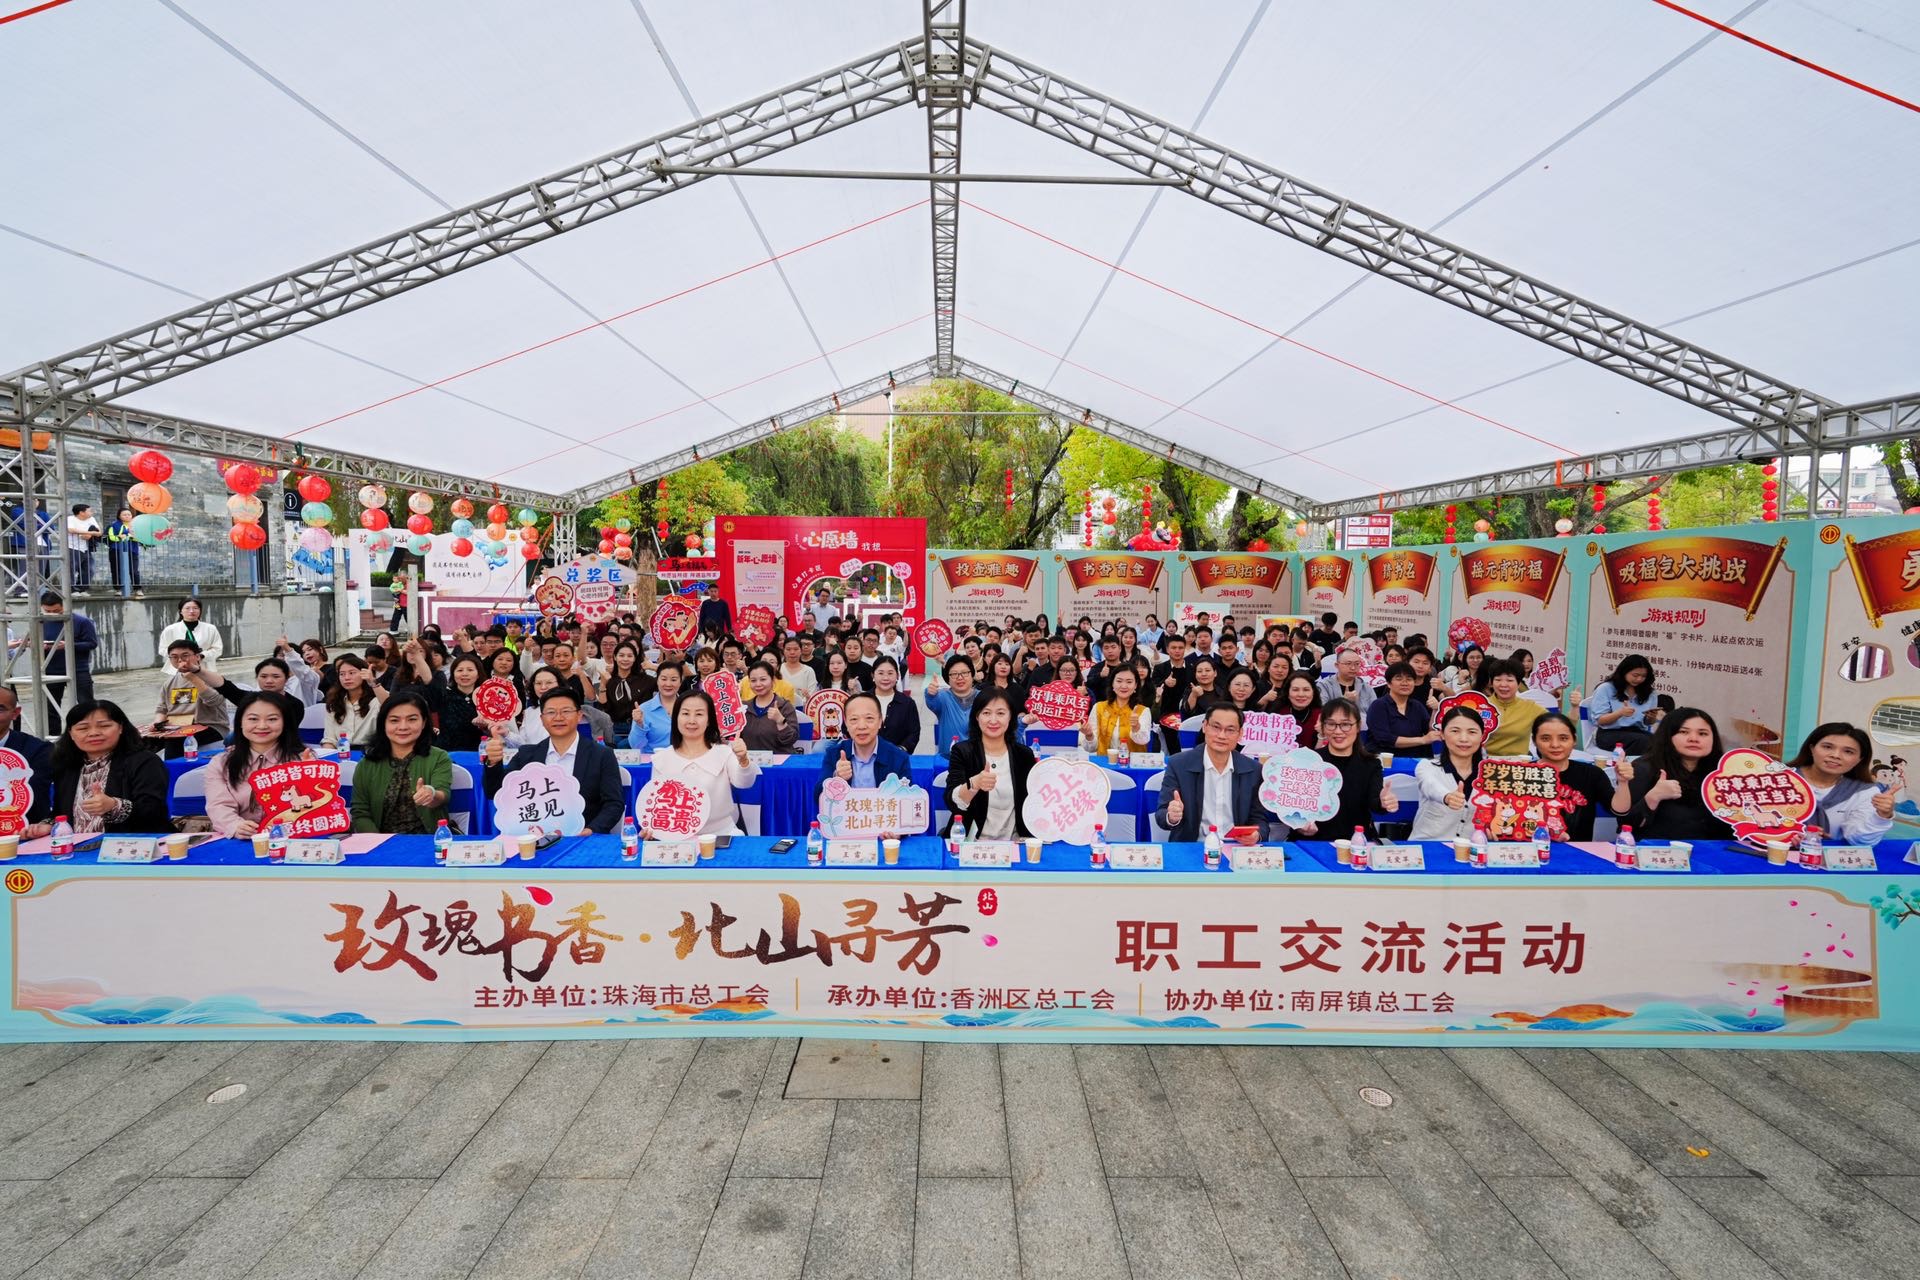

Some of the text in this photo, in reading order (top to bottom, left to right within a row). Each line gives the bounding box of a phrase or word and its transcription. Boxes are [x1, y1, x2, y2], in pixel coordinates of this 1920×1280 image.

[803, 530, 858, 549] 心愿墙
[862, 542, 881, 551] 我想
[737, 554, 777, 564] 新年心愿墙
[566, 568, 622, 582] 兑奖区
[955, 562, 1019, 578] 投壶雅趣
[1208, 563, 1268, 579] 年画拓印
[1472, 560, 1543, 582] 摇元宵祈福
[1619, 554, 1748, 585] 吸福气大挑战
[968, 588, 1004, 598] 游戏规则
[1094, 589, 1130, 598] 游戏规则
[1217, 589, 1254, 598] 游戏规则
[1483, 599, 1521, 614] 游戏规则
[1641, 608, 1706, 628] 游戏规则
[1841, 636, 1861, 650] 平安
[1538, 656, 1559, 669] 马到
[1541, 666, 1561, 678] 成功
[715, 679, 736, 726] 马上合拍
[1030, 688, 1089, 710] 好事乘风至
[1031, 702, 1088, 724] 鸿运正当头
[1243, 712, 1294, 730] 玫瑰书香
[1243, 727, 1294, 745] 北山寻芳
[1483, 763, 1556, 783] 岁岁皆胜意
[516, 777, 560, 800] 马上
[1039, 773, 1083, 808] 马上
[1279, 781, 1321, 798] 工缘牵
[1484, 779, 1557, 799] 年年常欢喜
[1715, 775, 1792, 791] 好事乘风至
[656, 780, 695, 810] 马上
[1277, 793, 1319, 812] 北山见
[518, 799, 565, 824] 遇见
[845, 798, 897, 812] 玫瑰书香
[1052, 790, 1099, 832] 结缘
[653, 807, 692, 832] 富贵
[845, 815, 897, 829] 北山寻芳
[982, 892, 994, 912] 北山
[323, 889, 970, 982] 玫瑰书香·北山寻芳
[1115, 920, 1586, 975] 职工交流活动
[473, 983, 1455, 1013] 主办单位：珠海市总工会 承办单位：香洲区总工会 协办单位：南屏镇总工会
